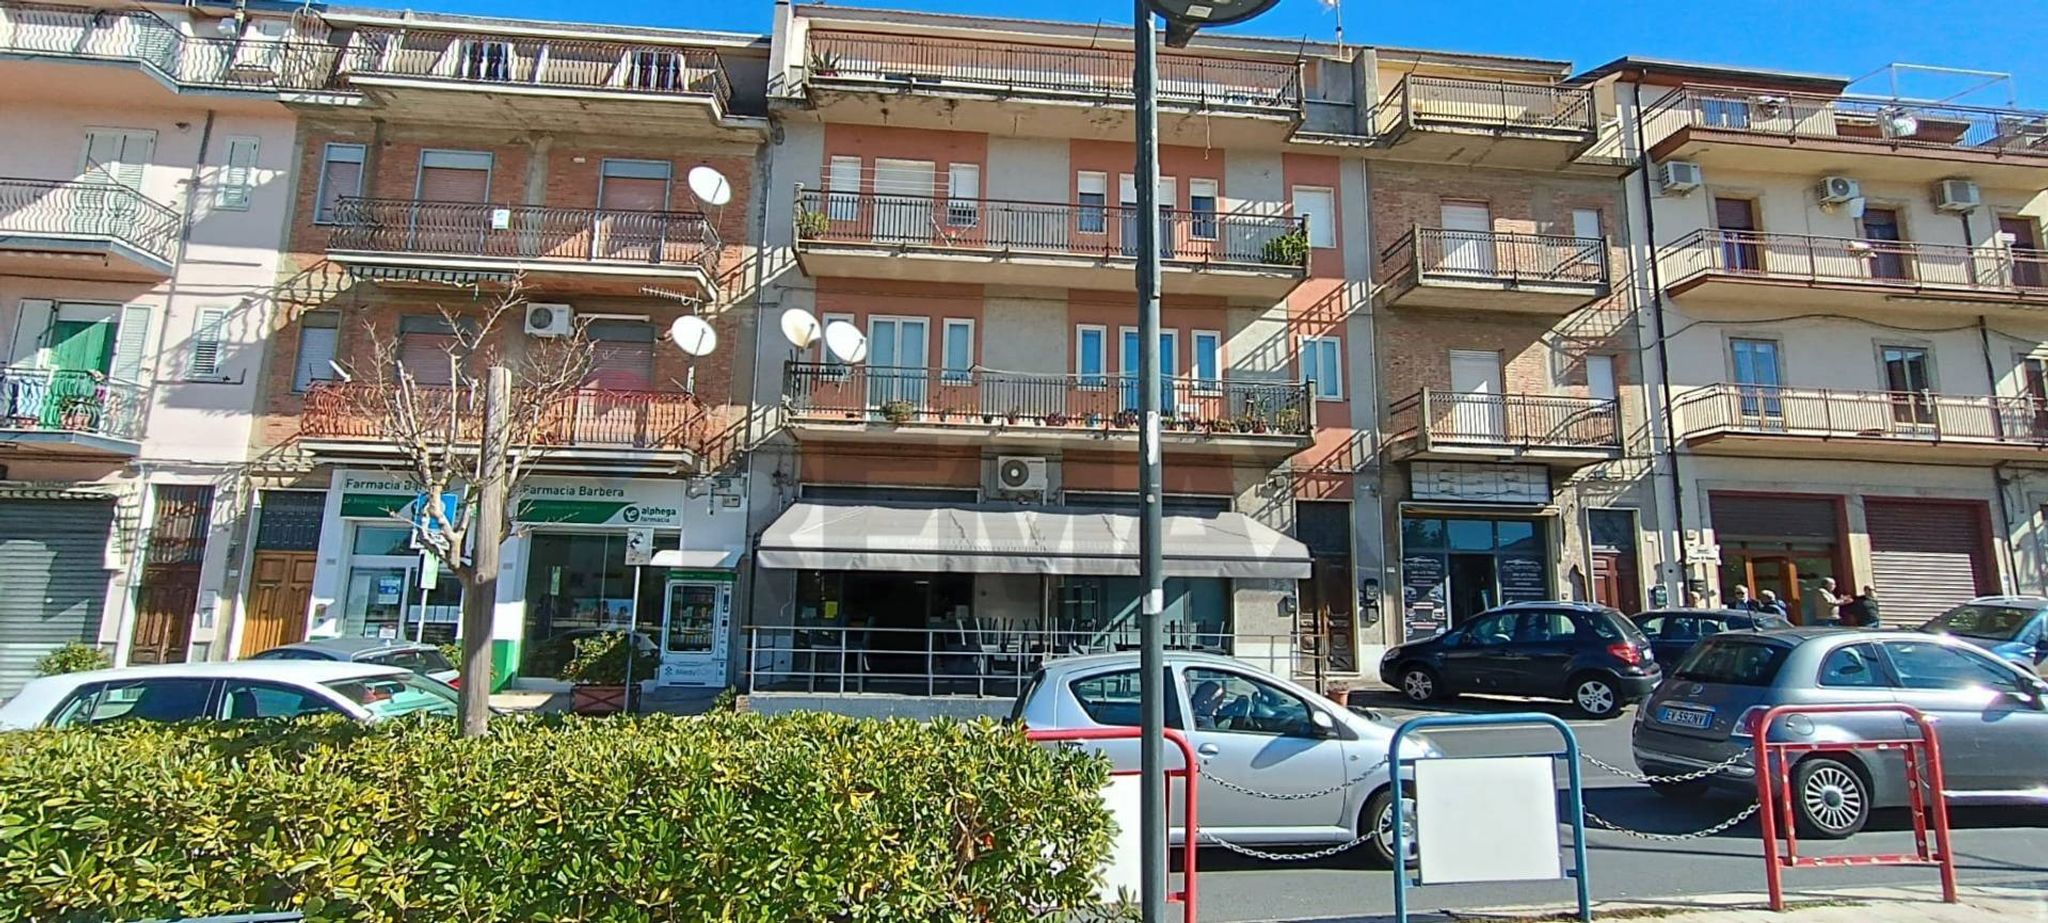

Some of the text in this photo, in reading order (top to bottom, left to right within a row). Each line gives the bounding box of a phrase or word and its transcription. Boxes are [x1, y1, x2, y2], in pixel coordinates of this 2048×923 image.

[345, 478, 400, 490] Farmacia
[523, 484, 625, 498] Farmacia Barbera
[641, 506, 676, 518] alphega
